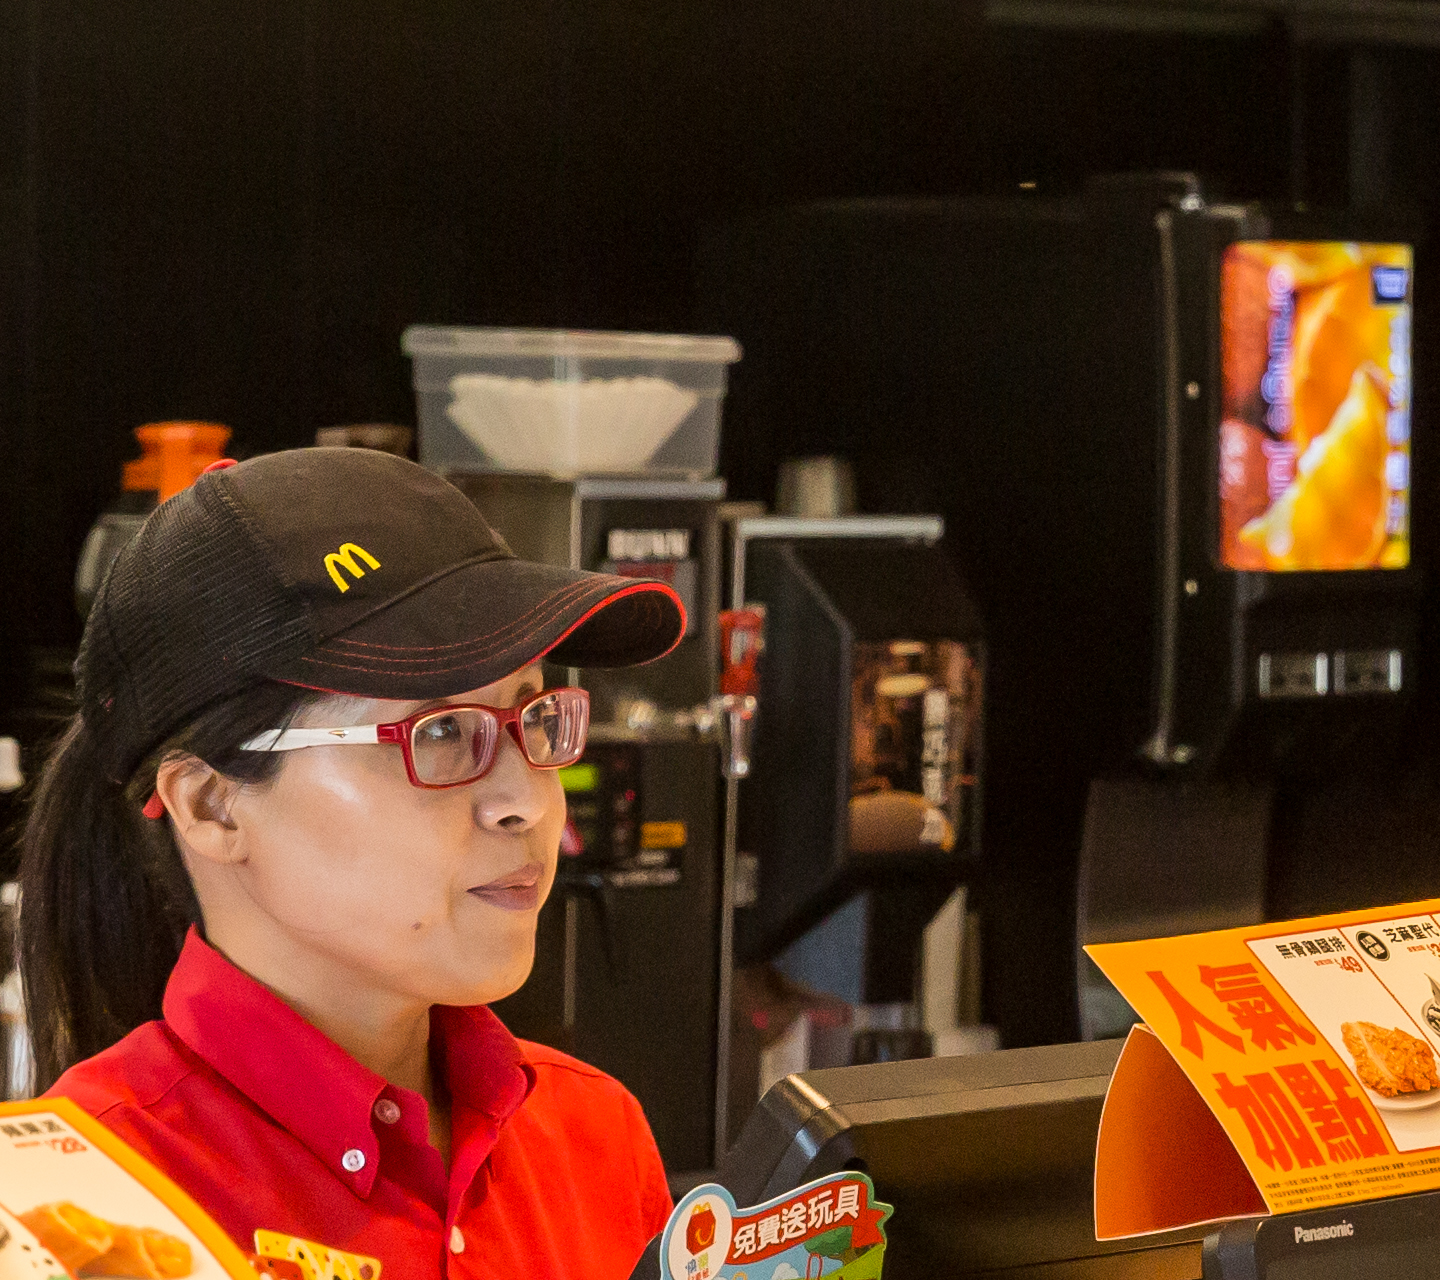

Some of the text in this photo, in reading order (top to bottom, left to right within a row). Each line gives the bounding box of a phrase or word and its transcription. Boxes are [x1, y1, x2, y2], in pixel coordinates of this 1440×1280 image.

[1382, 922, 1440, 943] 芝麻聖代
[1147, 963, 1316, 1060] 人氣
[1215, 1060, 1390, 1174] 加點
[732, 1183, 860, 1259] 免費送玩具
[1295, 1220, 1354, 1243] Panasonic
